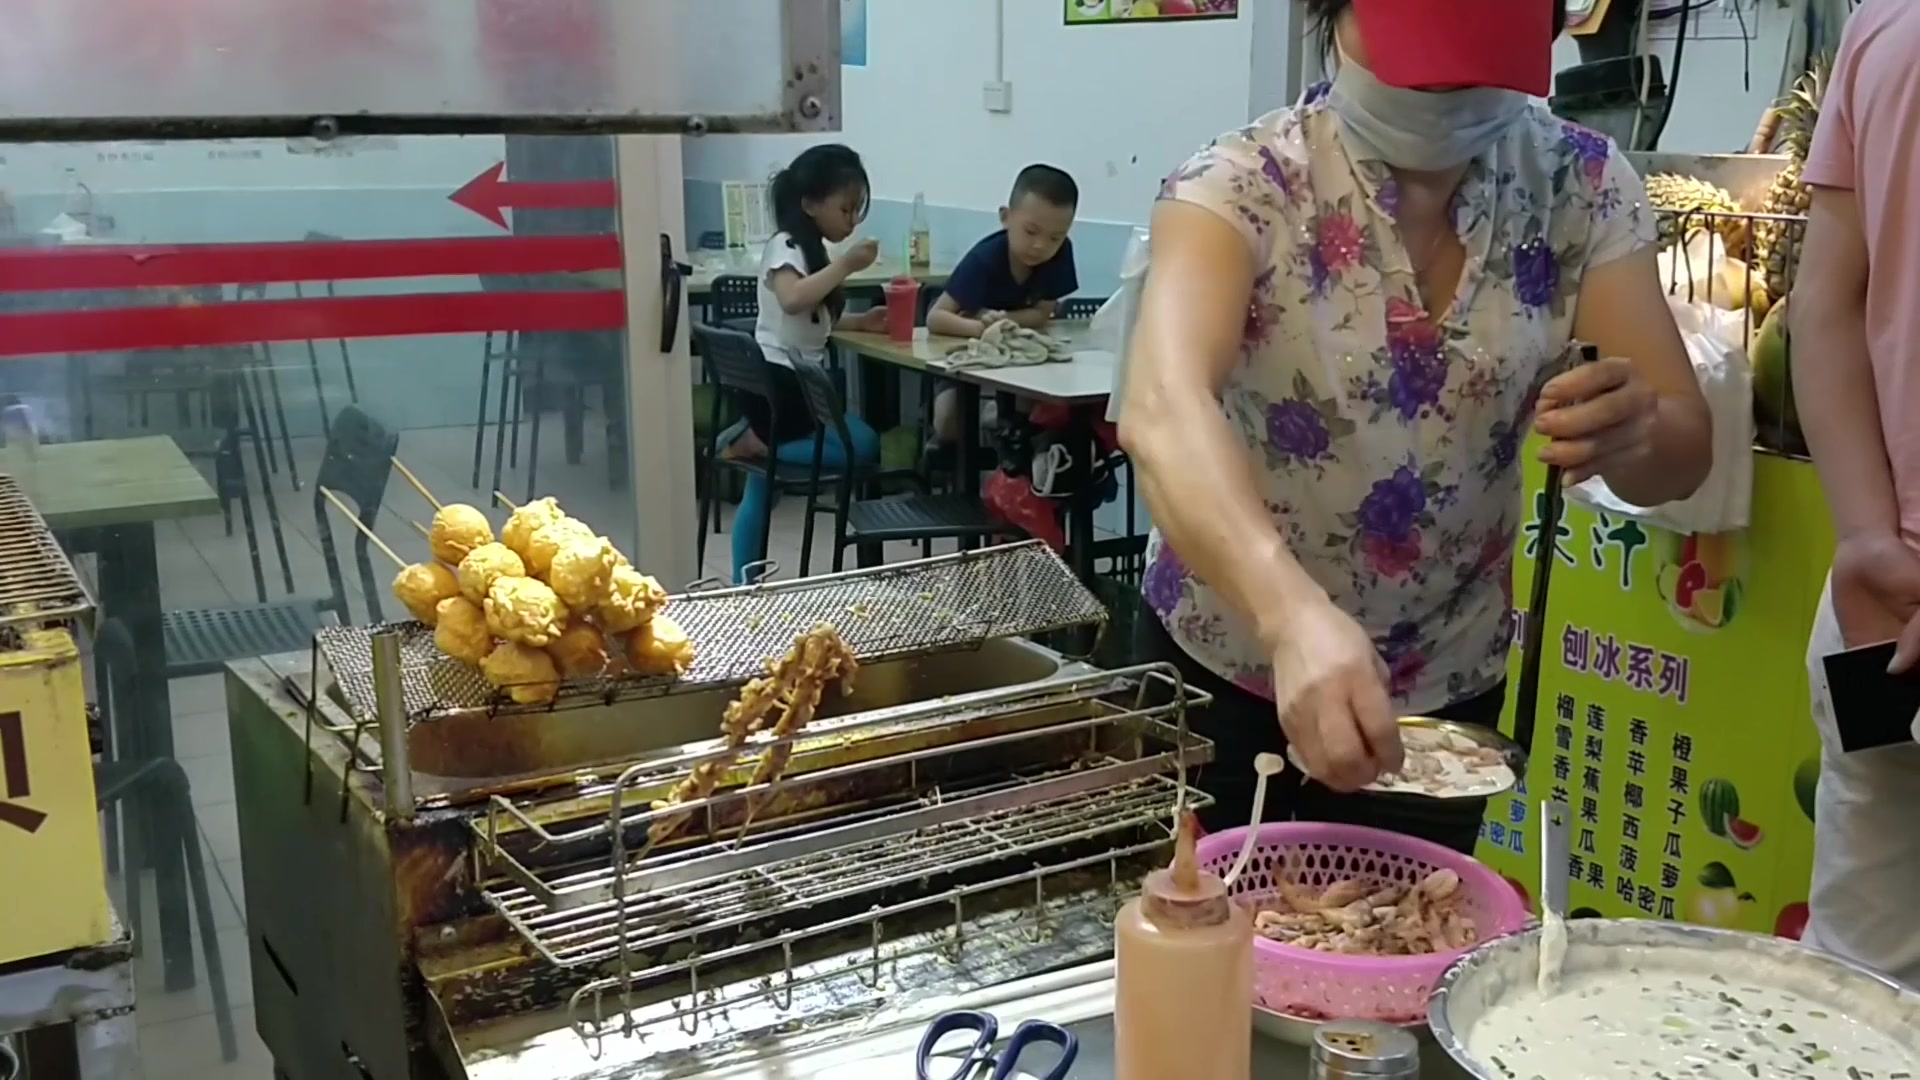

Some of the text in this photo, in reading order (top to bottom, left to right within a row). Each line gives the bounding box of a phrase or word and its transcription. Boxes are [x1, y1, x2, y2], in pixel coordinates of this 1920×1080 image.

[1562, 623, 1688, 702] 刨冰系列
[1556, 691, 1605, 732] 榴莲
[1555, 723, 1603, 763] 雪梨
[1553, 754, 1601, 794] 香蕉
[1568, 853, 1605, 890] 香果
[1616, 875, 1675, 920] 哈密瓜
